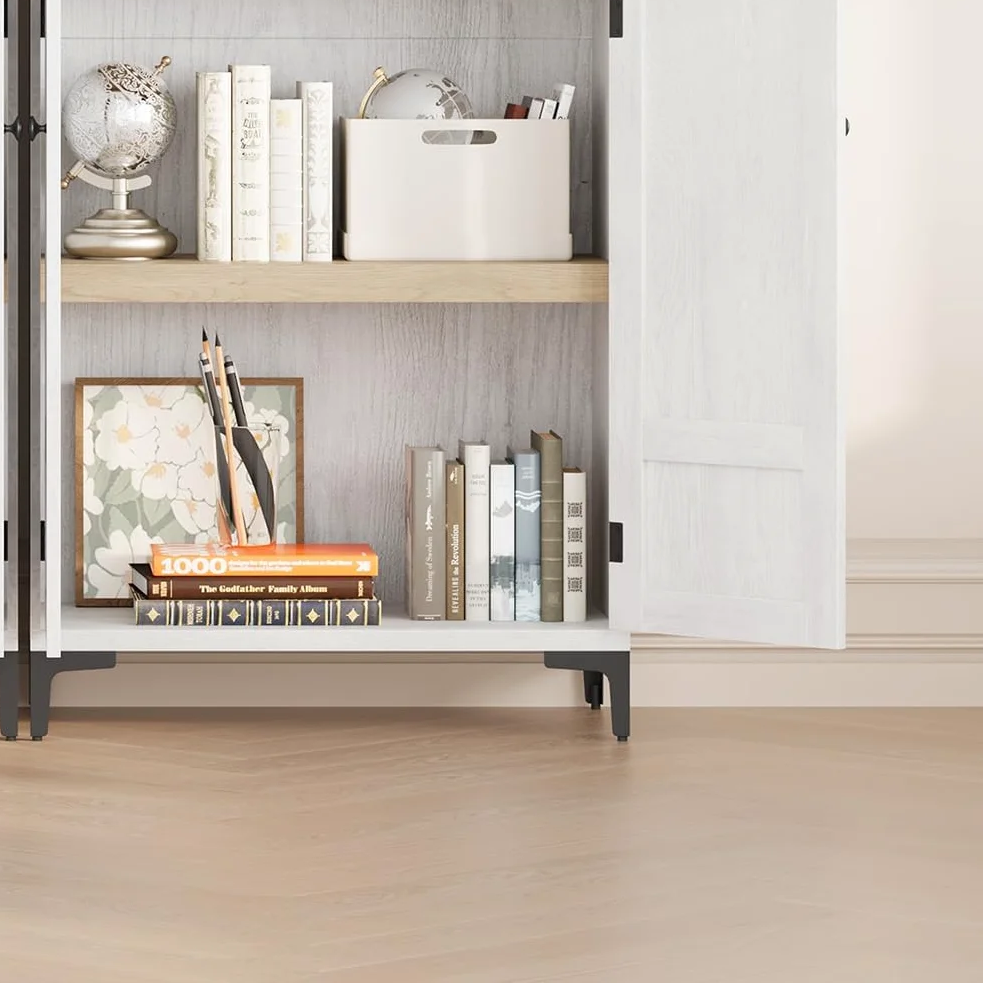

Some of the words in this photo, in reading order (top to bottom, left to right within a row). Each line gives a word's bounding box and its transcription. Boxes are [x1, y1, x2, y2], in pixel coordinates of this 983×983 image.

[425, 536, 433, 562] Sweden
[450, 524, 460, 566] Revolution
[160, 557, 227, 575] 1000
[425, 562, 434, 570] of
[199, 585, 218, 593] The
[219, 584, 266, 593] Godfather
[268, 585, 298, 595] Family
[299, 584, 328, 593] Album
[425, 570, 435, 602] Dreaming
